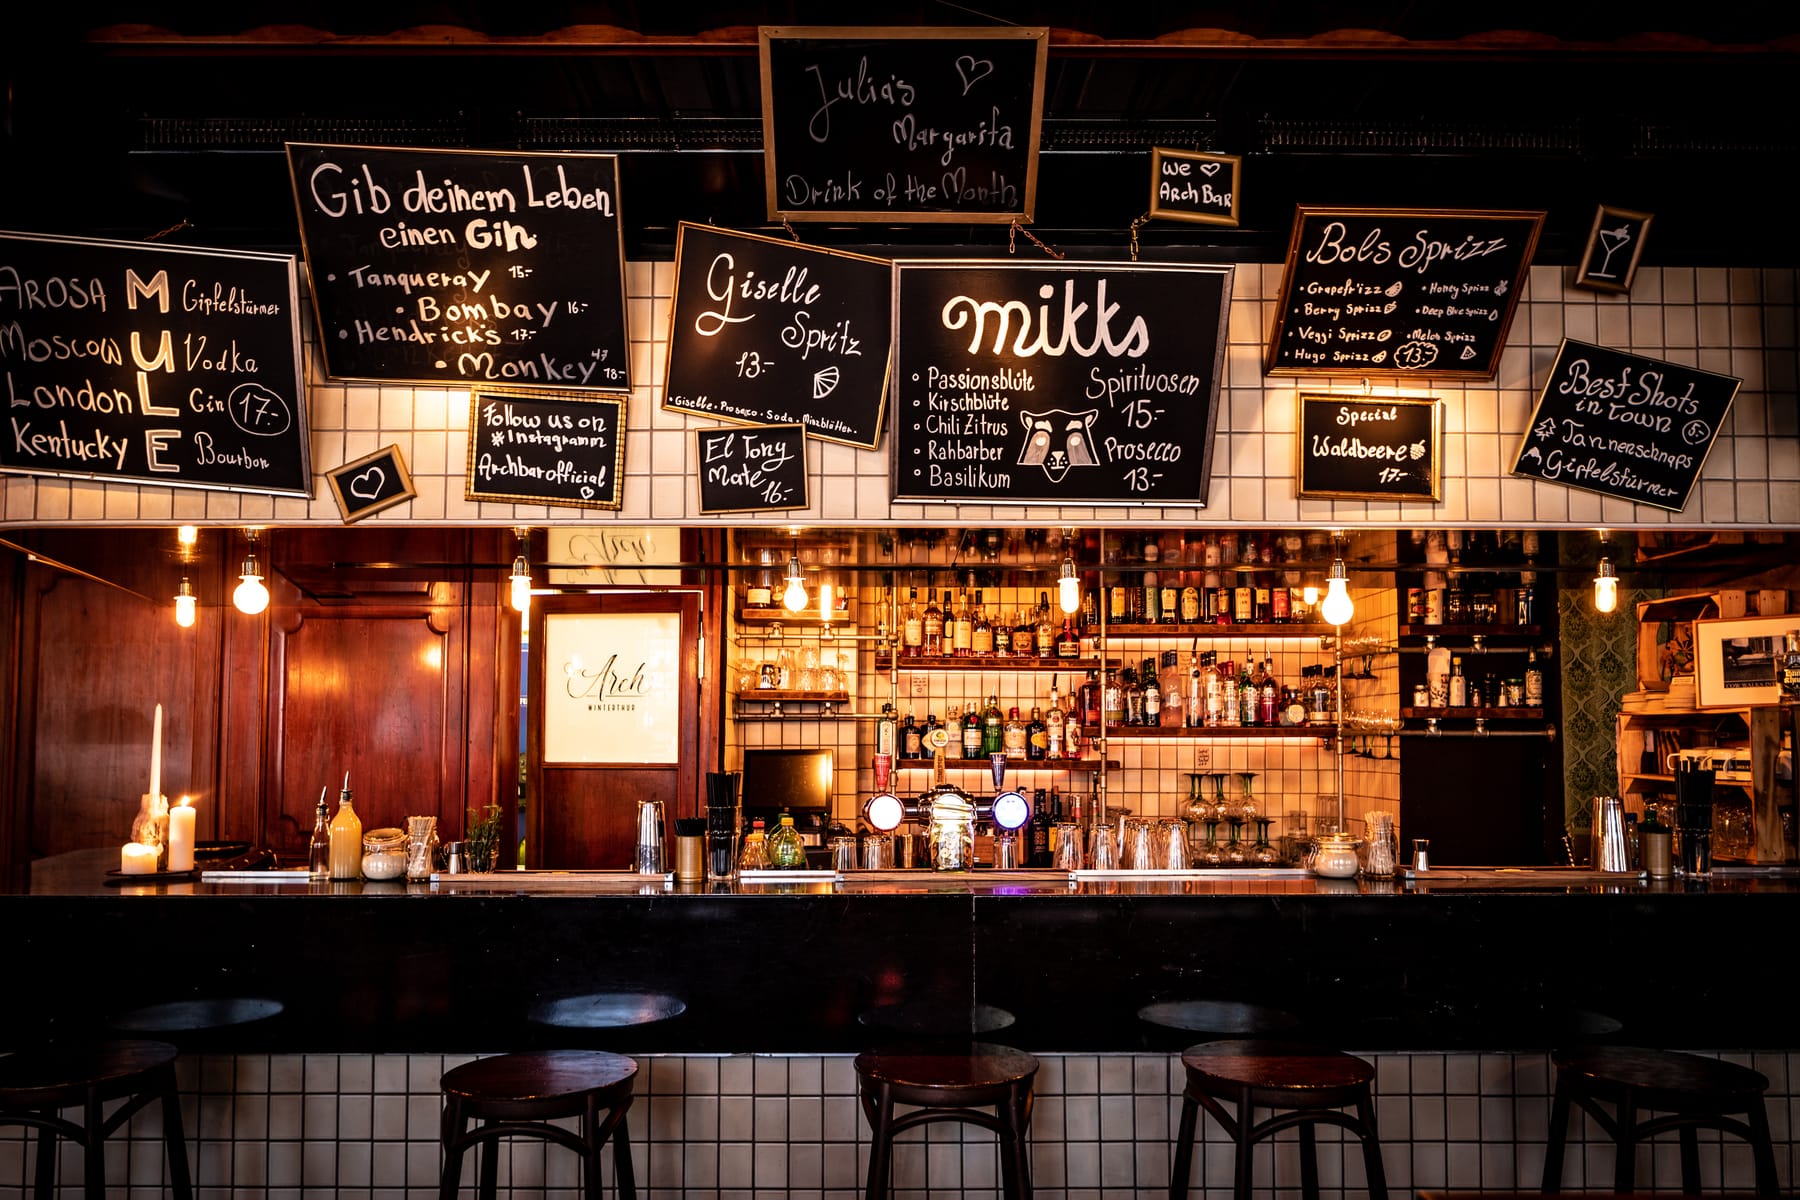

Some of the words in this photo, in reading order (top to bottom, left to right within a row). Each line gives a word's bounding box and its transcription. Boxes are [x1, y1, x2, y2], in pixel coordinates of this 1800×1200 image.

[805, 56, 915, 142] Julia's
[893, 106, 1014, 166] Margarita
[310, 163, 391, 217] Gib
[403, 170, 516, 214] deinem
[523, 164, 614, 217] Leben
[786, 171, 862, 206] Drink
[873, 172, 897, 206] of
[904, 174, 937, 203] the
[942, 166, 1018, 207] Month
[380, 222, 456, 249] einen
[1306, 221, 1392, 265] Bols
[1399, 229, 1508, 274] Sprizz
[0, 266, 106, 312] AROSA
[348, 264, 490, 295] Tanqueray
[695, 252, 821, 336] Giselle
[1429, 282, 1459, 300] Honey
[1461, 283, 1490, 295] Sprizz
[183, 279, 280, 316] Gipfelstürmer
[417, 295, 558, 328] Bombay
[1304, 302, 1340, 321] Berry
[1346, 303, 1382, 316] Sprizz
[1422, 305, 1444, 318] Deep
[1446, 306, 1465, 316] Blue
[354, 319, 501, 345] Hendrick's
[942, 278, 1149, 358] mikks
[0, 320, 122, 366] Moscow
[781, 311, 862, 360] Spritz
[1299, 325, 1333, 345] Veggi
[1339, 327, 1376, 343] Sprizz
[1412, 328, 1441, 341] Melon
[1444, 331, 1476, 344] Sprizz
[184, 333, 259, 373] Vodka
[457, 352, 597, 385] Monkey
[1295, 348, 1326, 364] Hugo
[1333, 351, 1369, 363] Sprizz
[7, 370, 132, 414] London
[189, 387, 224, 413] Gin
[928, 392, 1009, 412] Kirschblüte
[1086, 363, 1200, 408] Spirituosen
[1559, 359, 1631, 398] Best
[1628, 371, 1700, 415] Shots
[482, 402, 541, 428] Follow
[548, 414, 573, 429] us
[578, 416, 607, 433] on
[675, 396, 712, 410] Giselle
[766, 409, 793, 423] Soda
[1336, 406, 1398, 427] Special
[1575, 397, 1604, 415] in
[926, 413, 960, 435] Chili
[963, 413, 1008, 436] Zitrus
[11, 417, 128, 471] Kentucky
[194, 431, 270, 470] Bourbon
[705, 433, 735, 463] El
[742, 434, 795, 472] Tony
[1104, 436, 1181, 462] Prosecco
[1312, 434, 1408, 462] Waldbeere
[1562, 419, 1693, 470] Tannenschnaps
[708, 463, 767, 488] Mate
[929, 464, 1010, 489] Basilikum
[1541, 449, 1679, 497] Gipfelstürmer
[563, 654, 655, 702] Arch
[588, 704, 636, 712] WINTERTHUR
